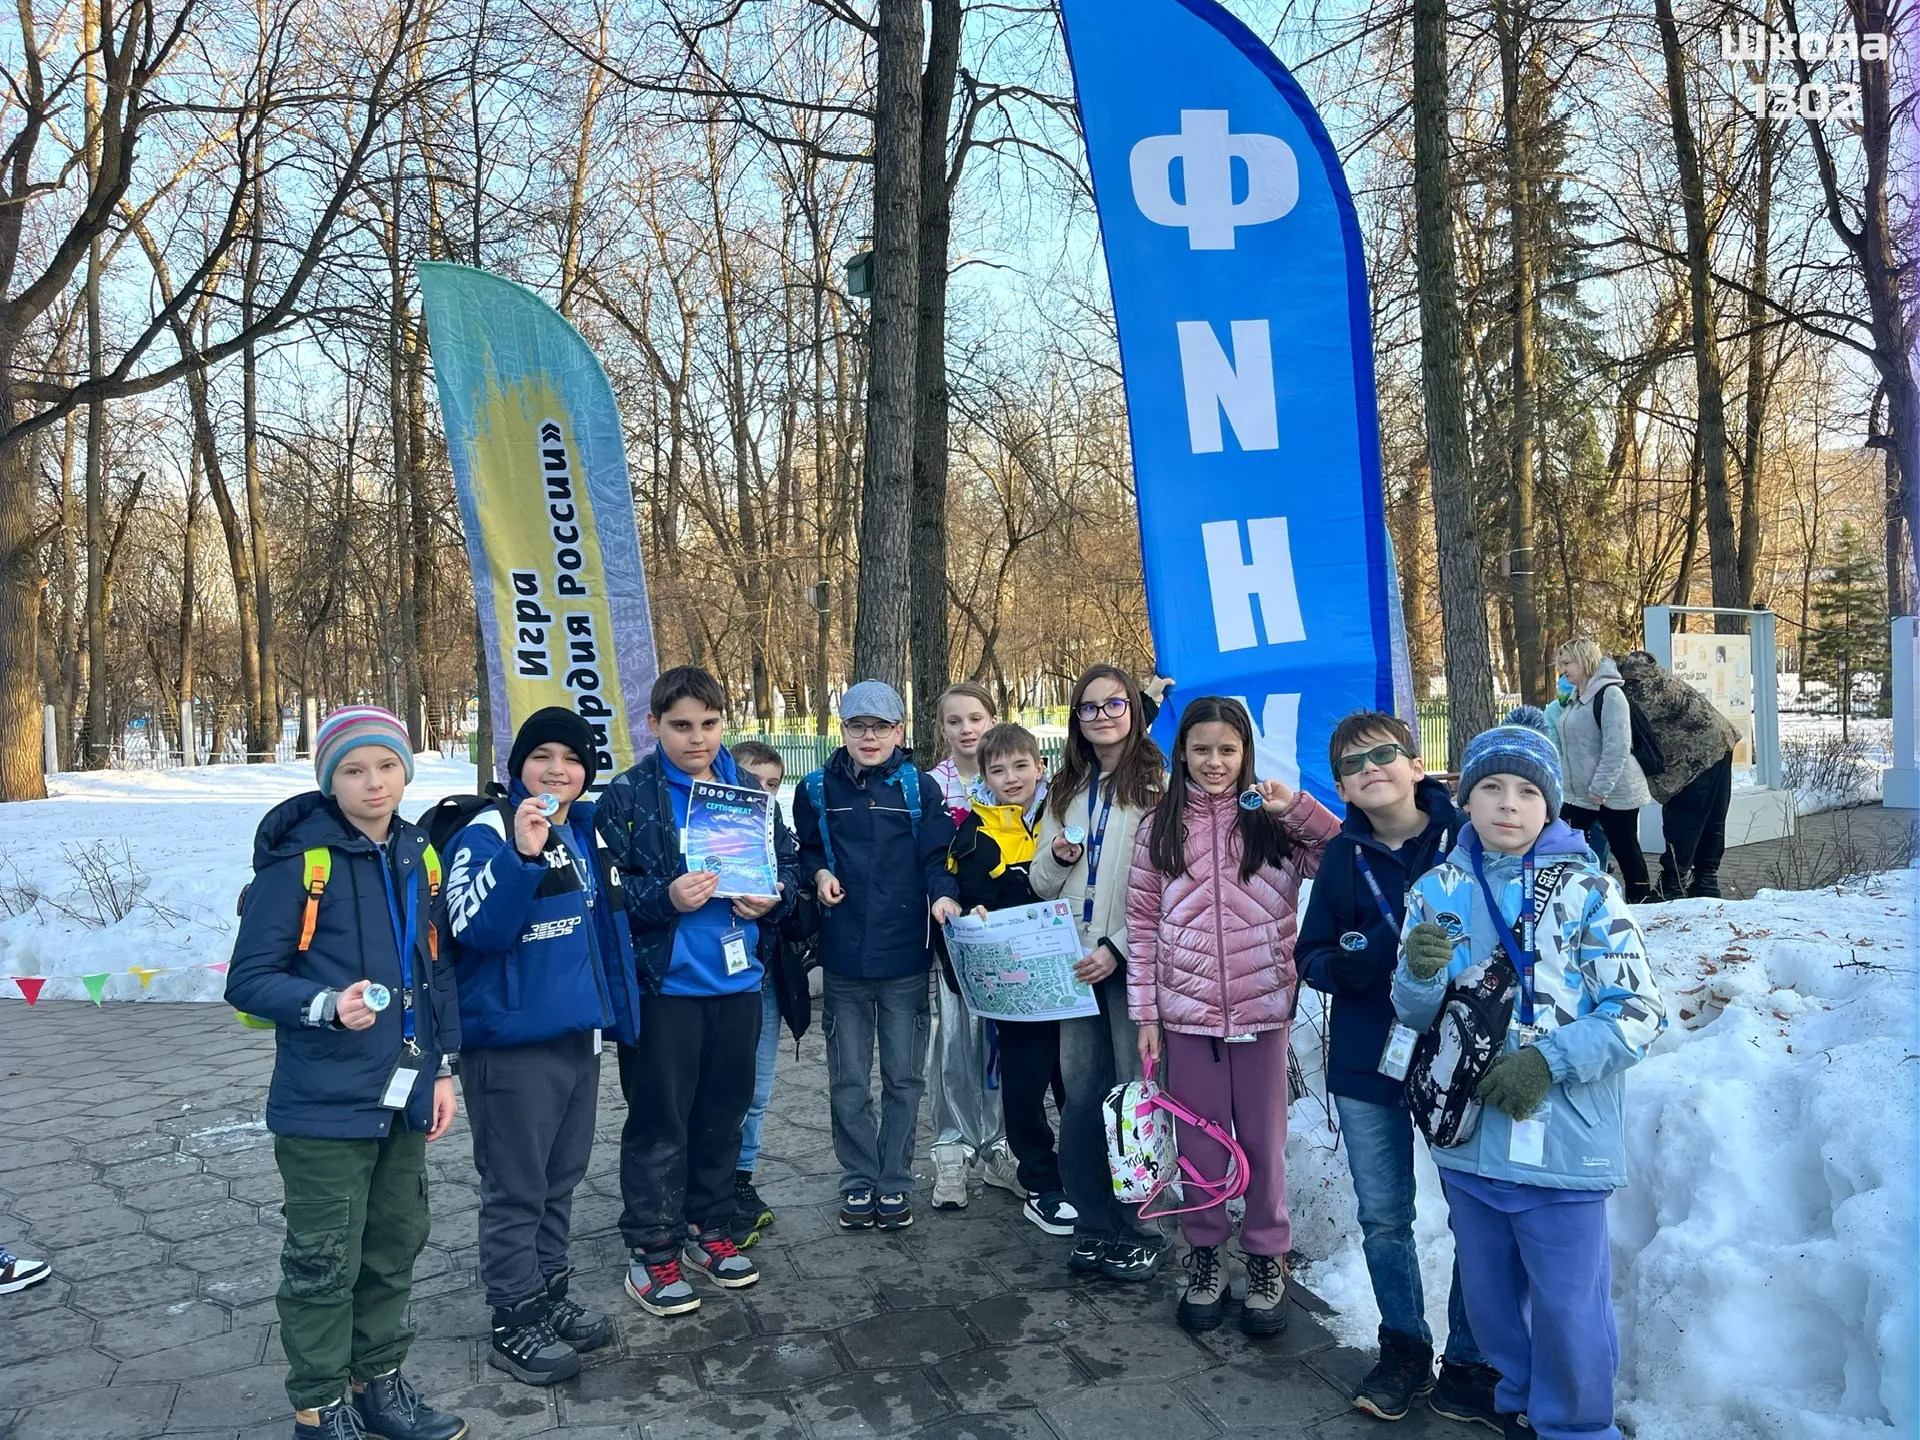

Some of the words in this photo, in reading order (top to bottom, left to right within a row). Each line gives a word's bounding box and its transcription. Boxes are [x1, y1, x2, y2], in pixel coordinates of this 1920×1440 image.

[541, 423, 586, 596] России»
[513, 573, 551, 676] Игра
[1674, 660, 1687, 670] МОЙ
[566, 616, 613, 792] вардия
[706, 802, 753, 815] СЕРТИФИКАТ
[531, 916, 581, 932] RECORD
[522, 926, 574, 942] SPEEDS
